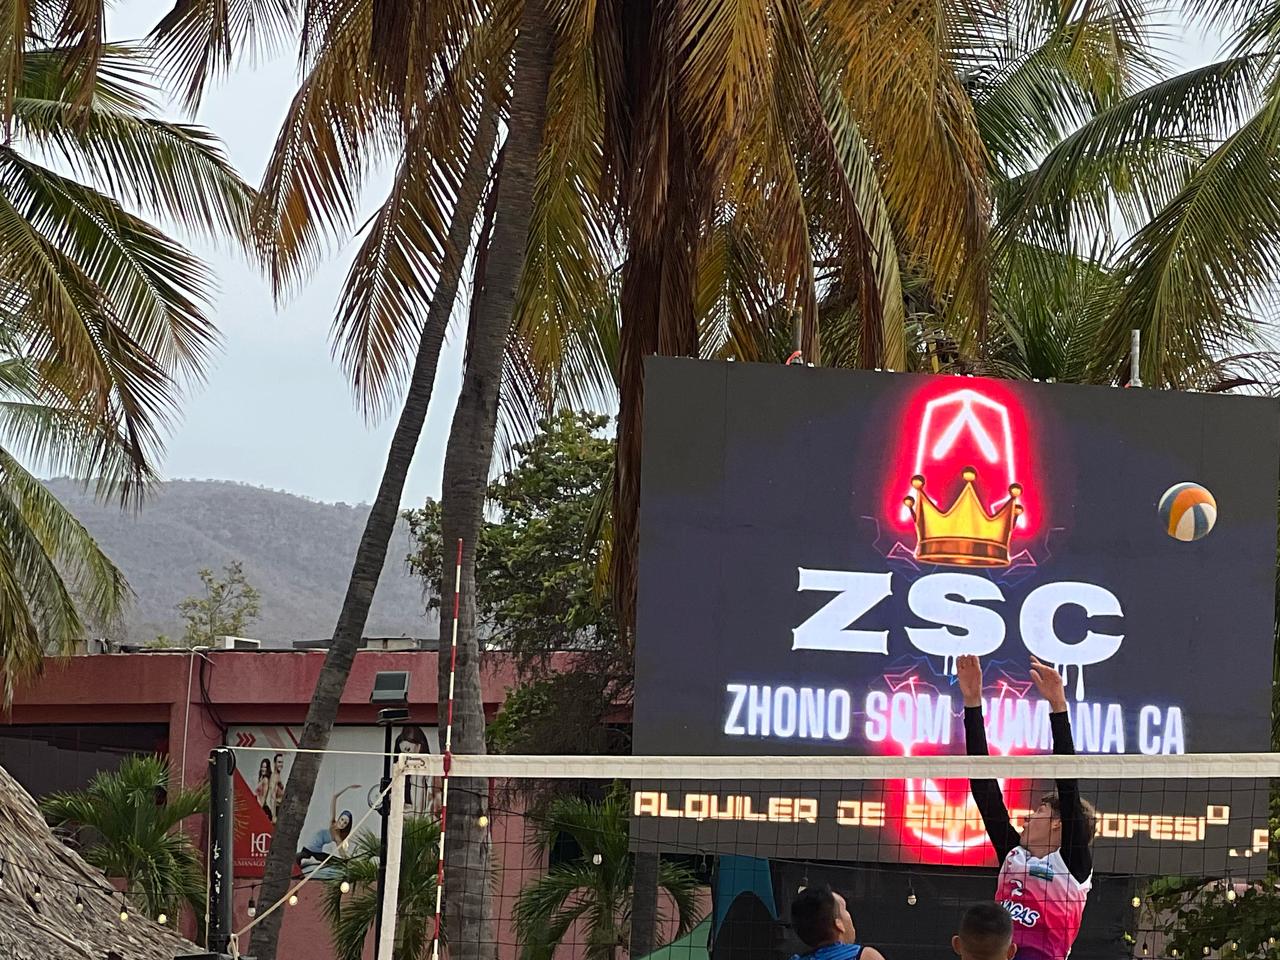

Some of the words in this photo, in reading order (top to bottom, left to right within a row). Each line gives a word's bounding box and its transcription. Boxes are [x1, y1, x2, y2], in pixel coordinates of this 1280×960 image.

[792, 567, 1125, 688] ZSC
[723, 684, 851, 741] ZHONO
[1138, 704, 1185, 755] CA
[634, 791, 818, 823] ALQUILER
[837, 800, 886, 827] DE
